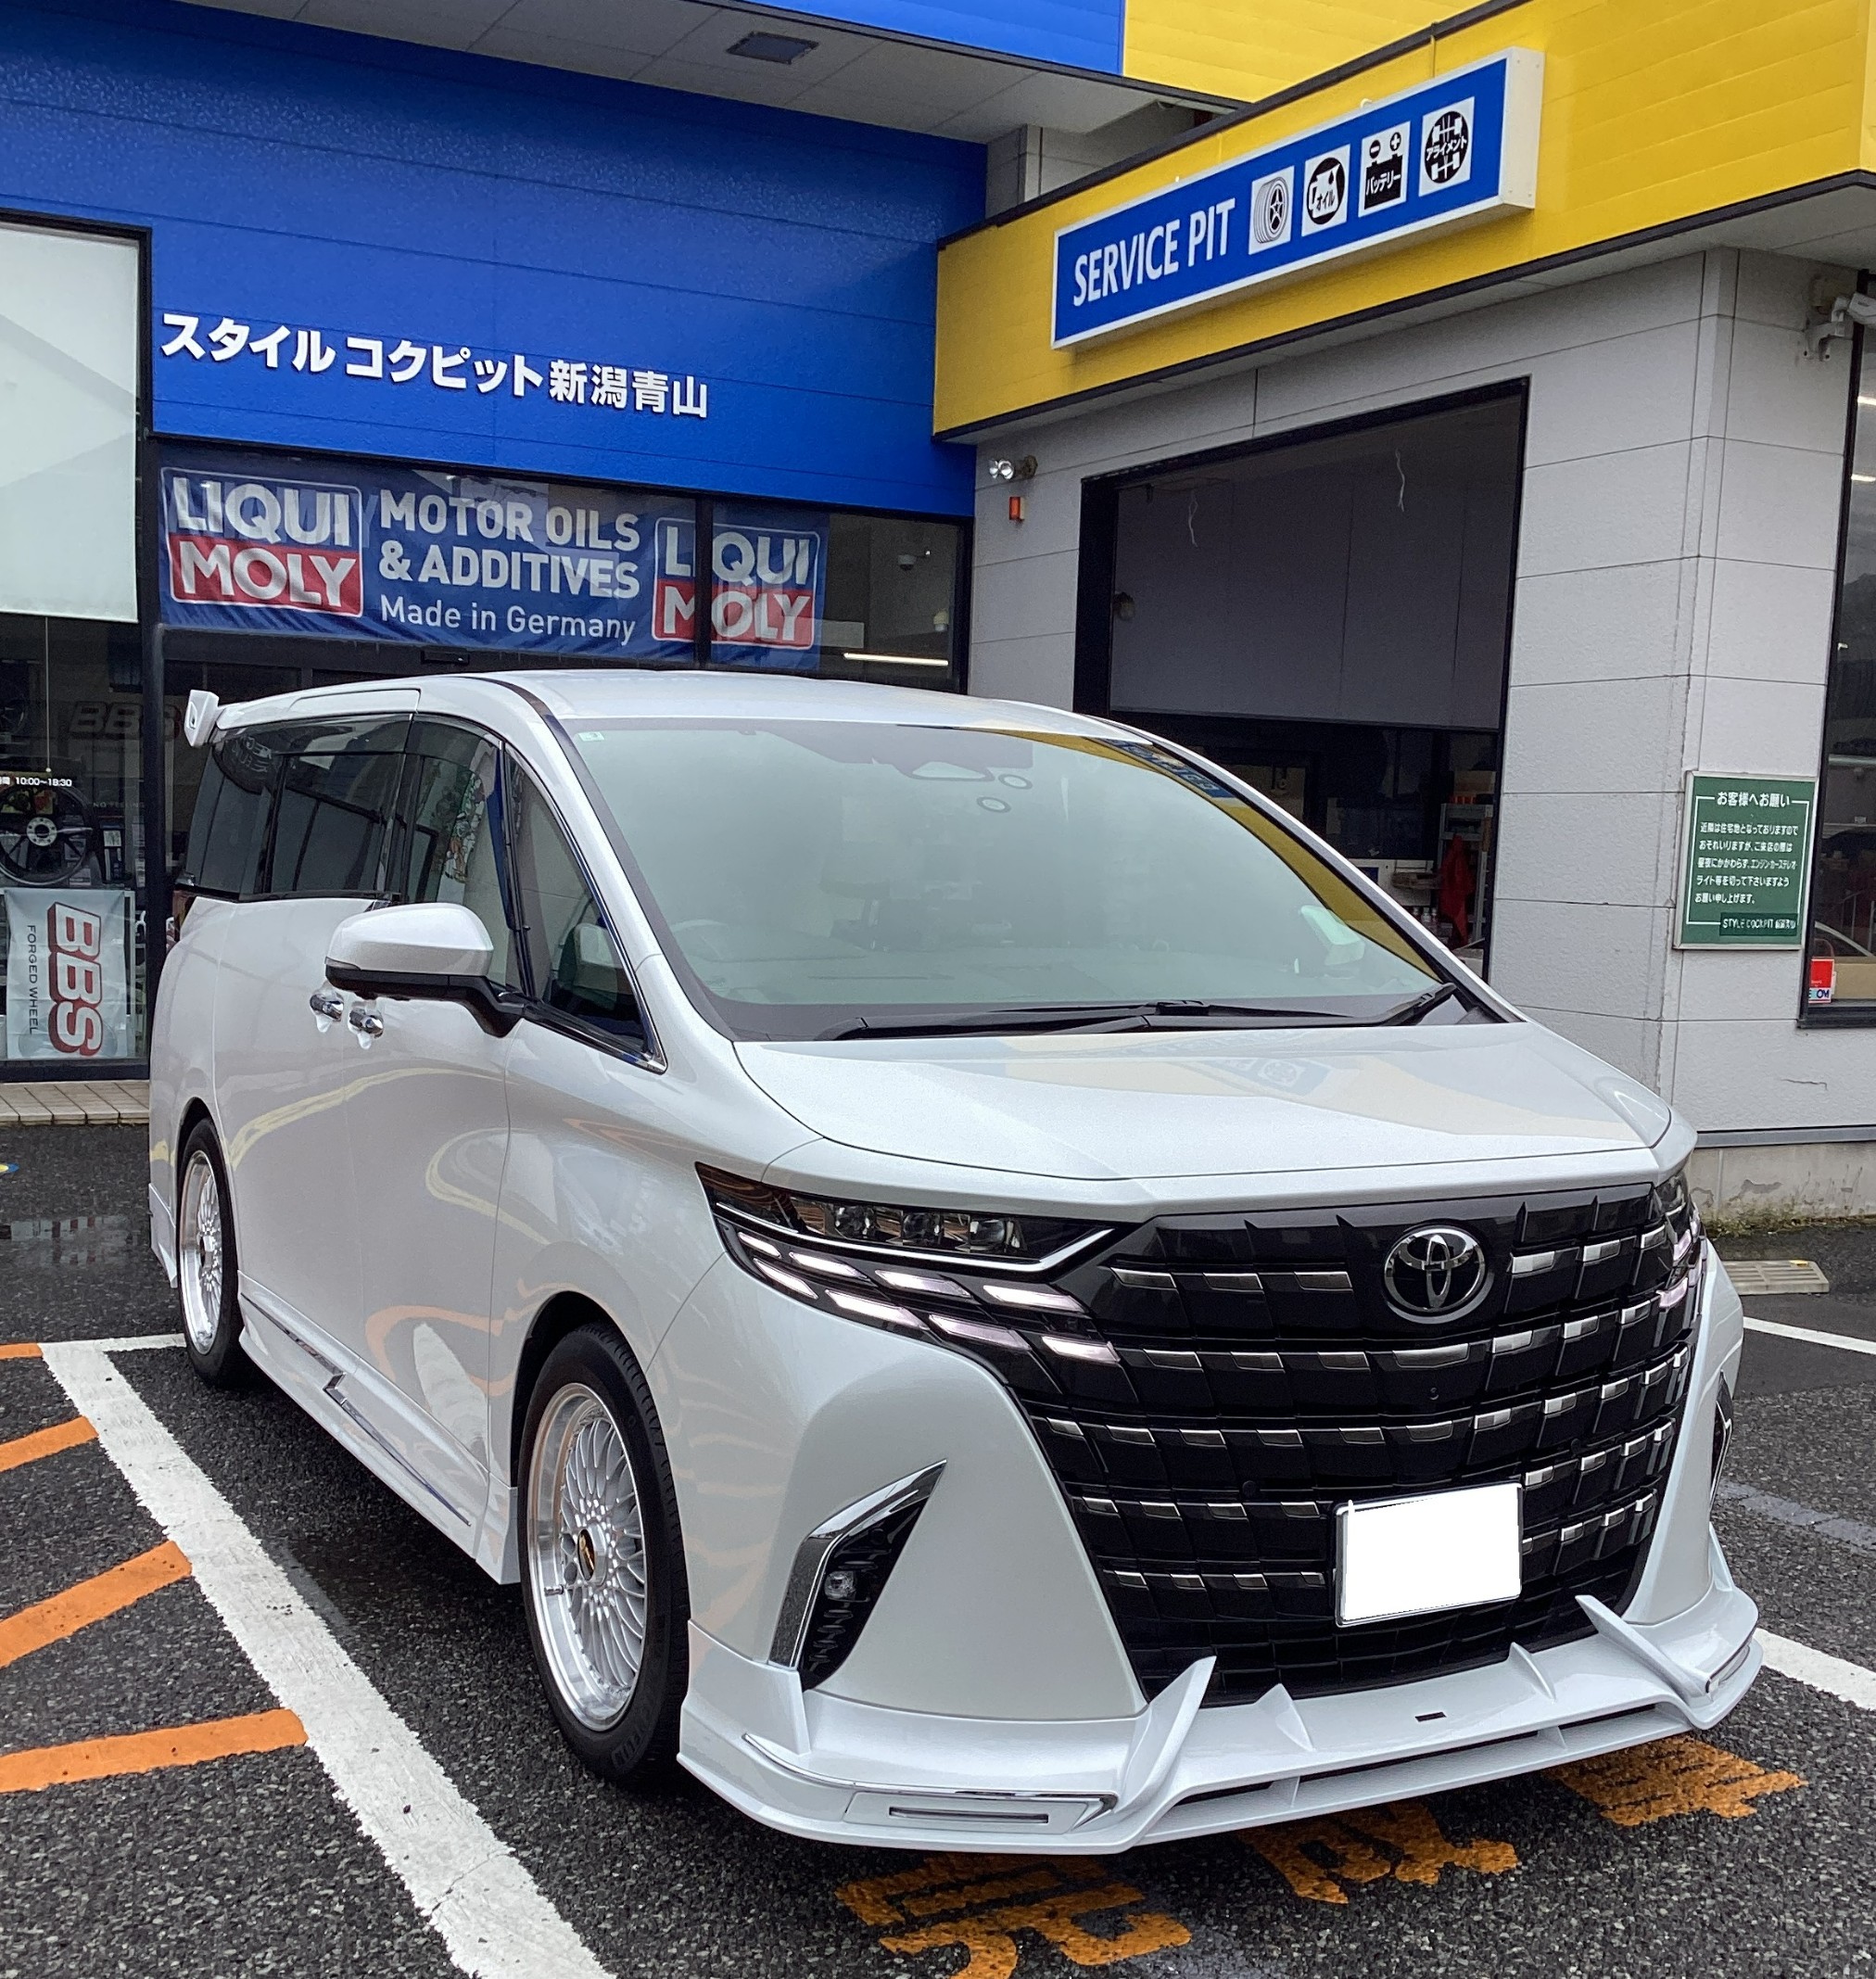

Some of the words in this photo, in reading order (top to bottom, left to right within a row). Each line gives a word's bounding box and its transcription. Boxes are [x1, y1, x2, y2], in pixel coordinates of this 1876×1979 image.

[1426, 134, 1468, 161] アライメント
[1316, 188, 1337, 210] オイル
[1365, 168, 1401, 197] バッテリー
[1073, 218, 1181, 307] SERVICE
[1187, 197, 1236, 268] PIT
[172, 476, 350, 547] LIQUI
[380, 488, 535, 542] MOTOR
[545, 506, 640, 552] OILS
[179, 540, 357, 607] MOLY
[378, 539, 413, 581] &
[418, 544, 640, 599] ADDITIVES
[665, 526, 810, 586] LQUI
[380, 594, 461, 628] Made
[471, 603, 497, 631] in
[507, 605, 636, 646] Germany
[664, 585, 811, 641] MOLY
[1717, 792, 1790, 807] お客様へお願い
[27, 924, 38, 983] FORGED
[46, 901, 104, 1057] BBS
[29, 986, 39, 1035] WHEEL
